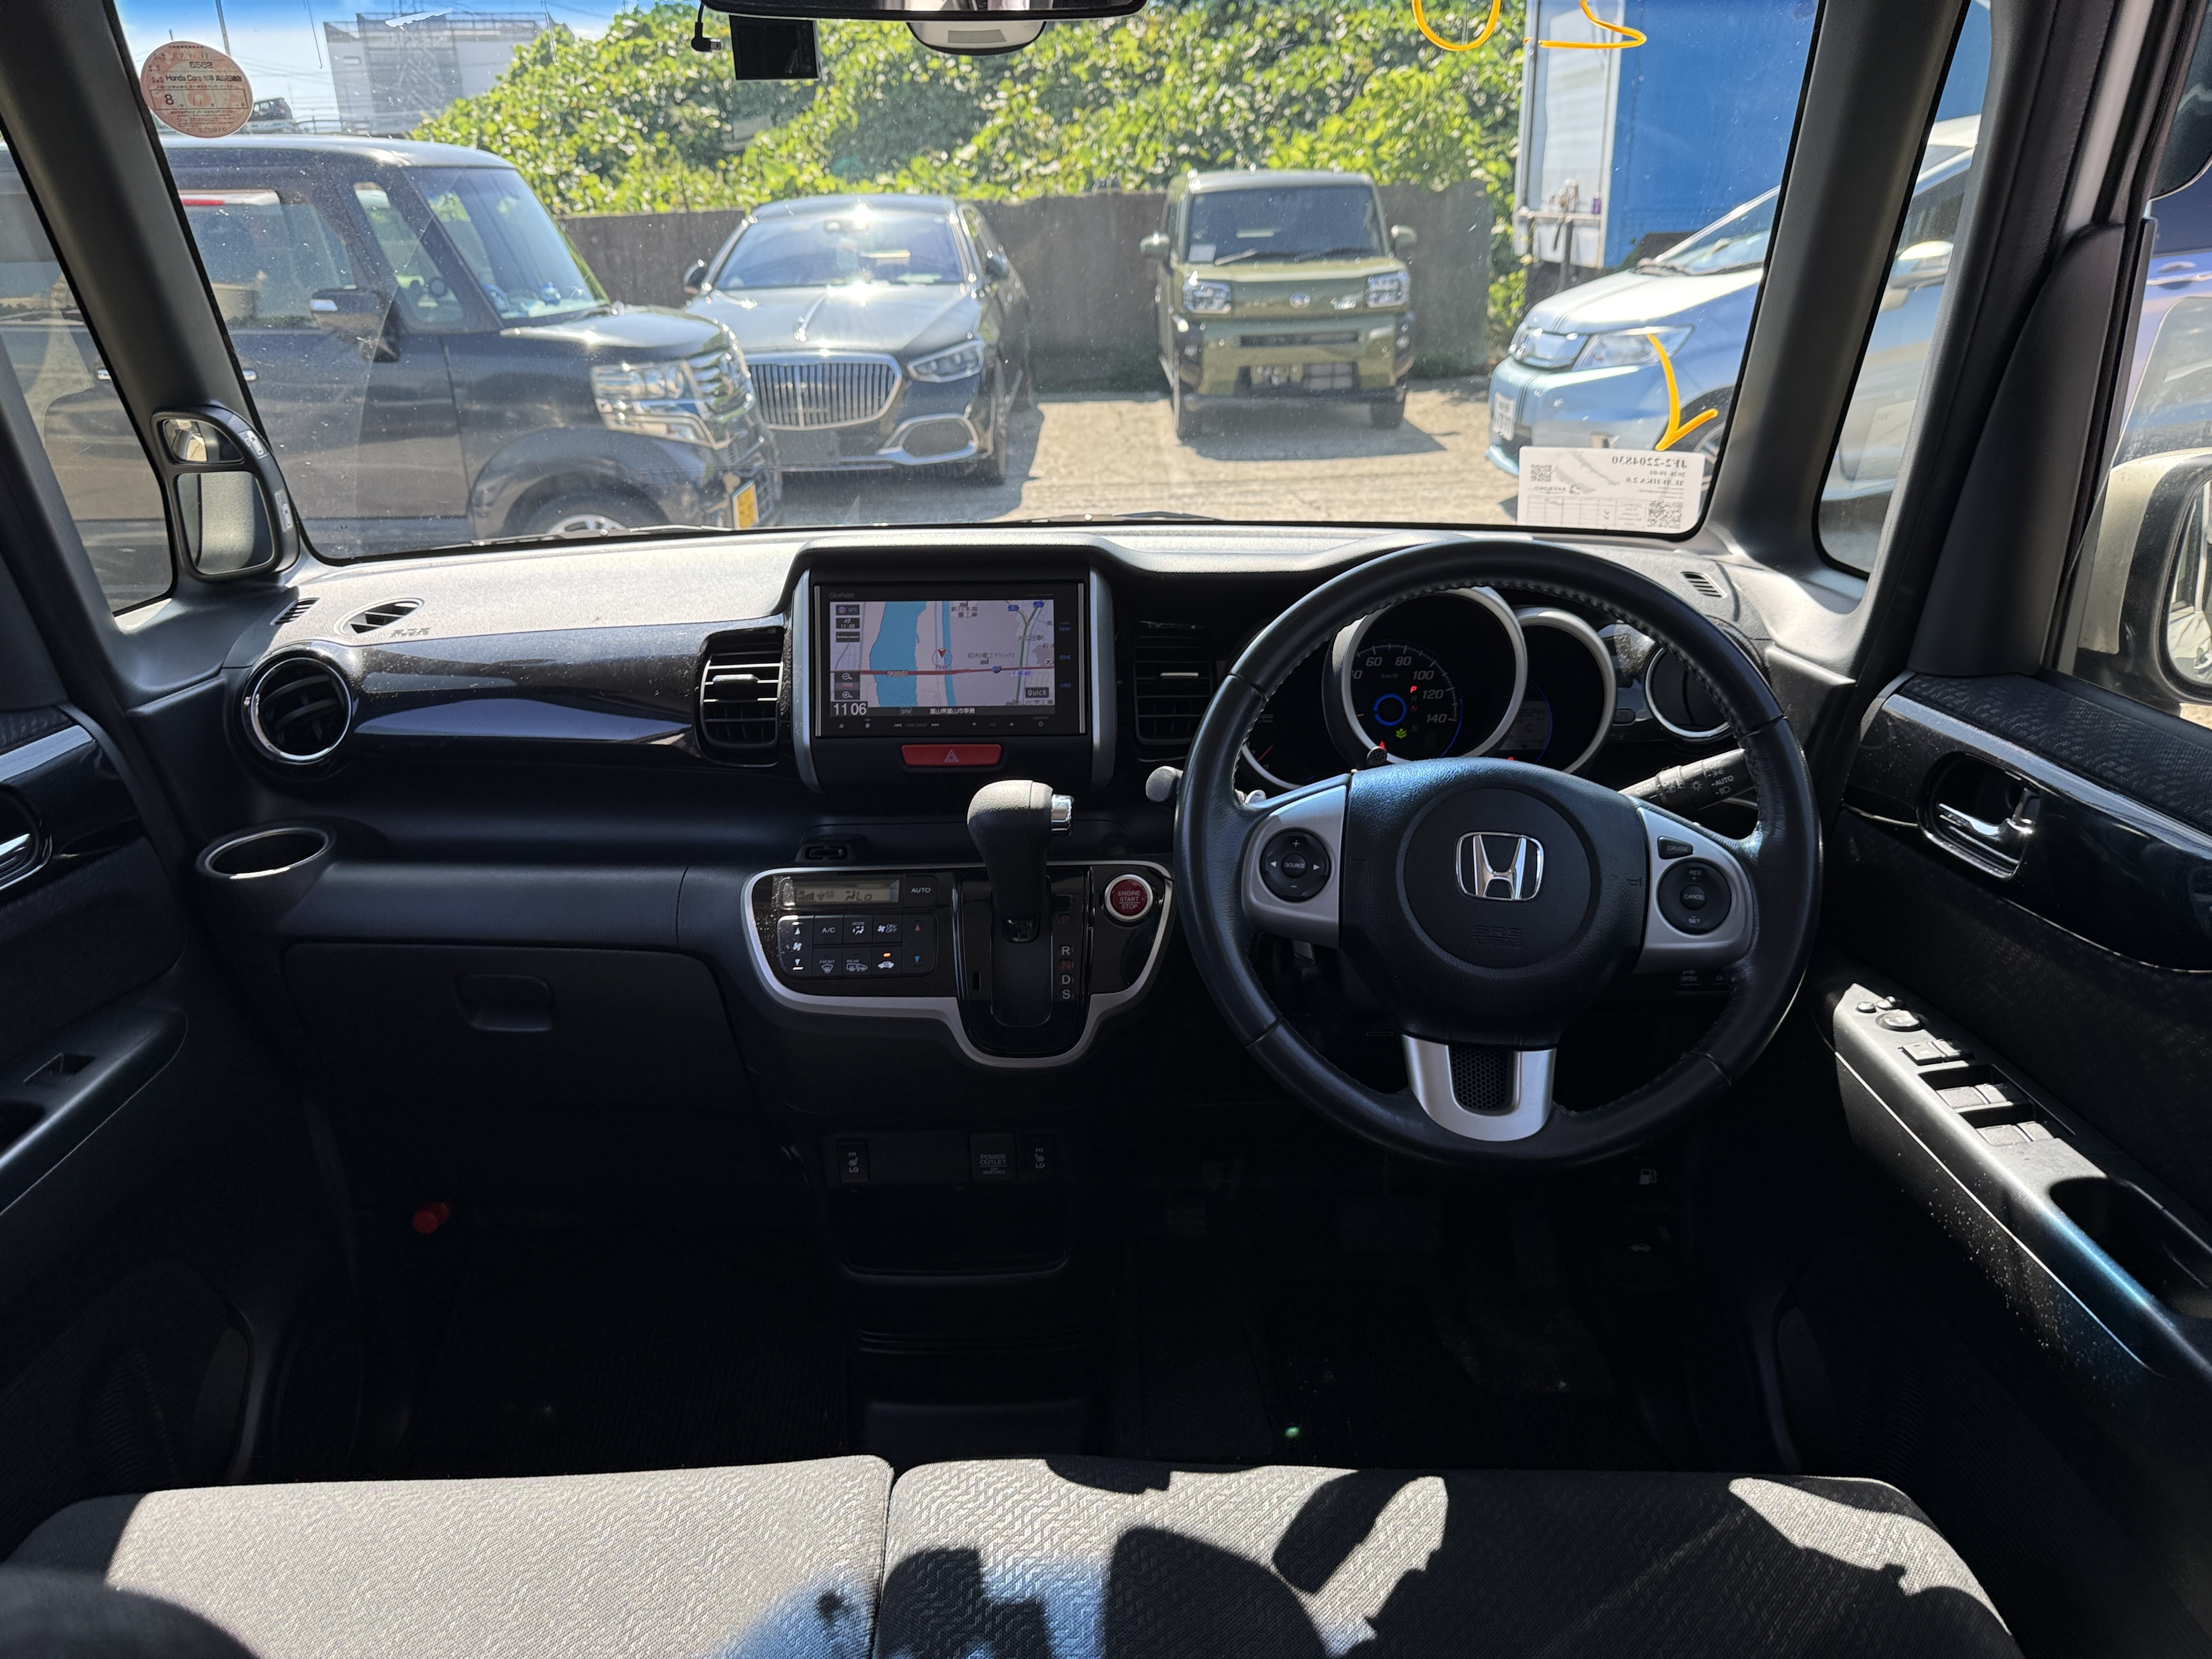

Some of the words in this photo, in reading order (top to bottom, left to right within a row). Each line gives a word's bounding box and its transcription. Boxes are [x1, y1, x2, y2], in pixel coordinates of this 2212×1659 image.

[164, 94, 174, 105] 8
[1365, 657, 1382, 667] 60
[1395, 656, 1412, 667] 80
[1412, 670, 1434, 680] 100
[1409, 685, 1418, 694] P
[1422, 689, 1444, 699] 120
[1426, 713, 1447, 724] 140
[1715, 775, 1734, 786] AUTO
[1062, 945, 1070, 955] R
[1062, 960, 1071, 970] N
[1062, 974, 1070, 985] D
[1062, 989, 1071, 1000] S
